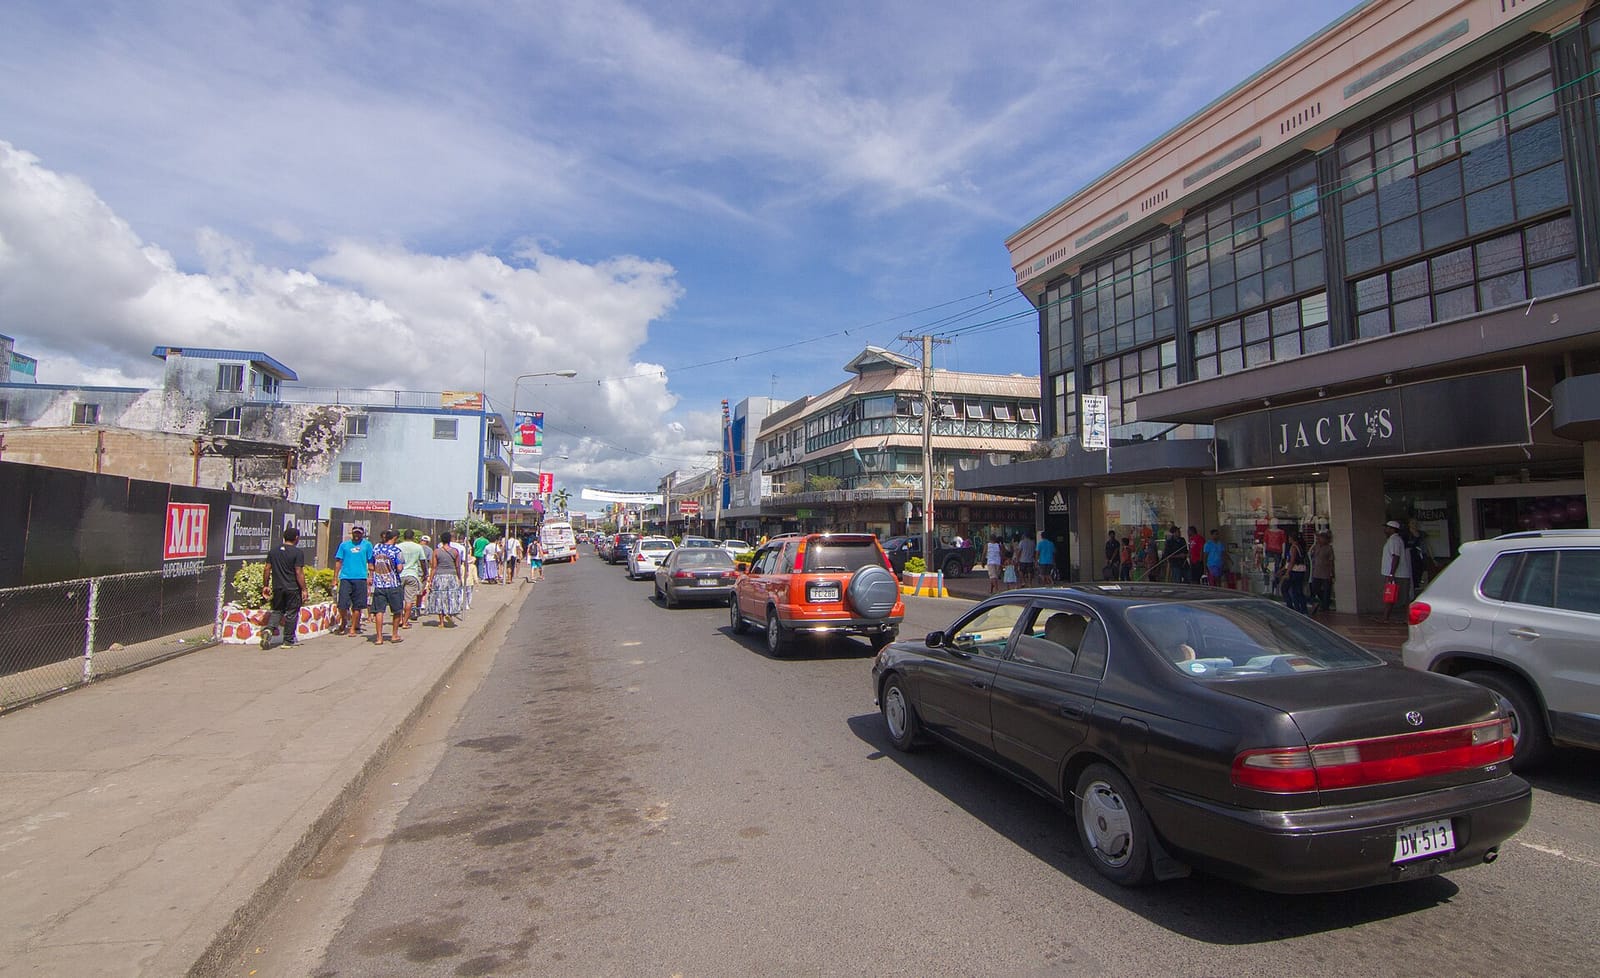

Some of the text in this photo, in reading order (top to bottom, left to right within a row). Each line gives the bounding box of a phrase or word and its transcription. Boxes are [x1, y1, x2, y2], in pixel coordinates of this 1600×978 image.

[1279, 407, 1393, 454] JACK'S
[1049, 503, 1068, 511] adidas
[169, 508, 206, 554] MH
[235, 521, 270, 537] Homemaker
[162, 560, 205, 579] SUPERMARKET
